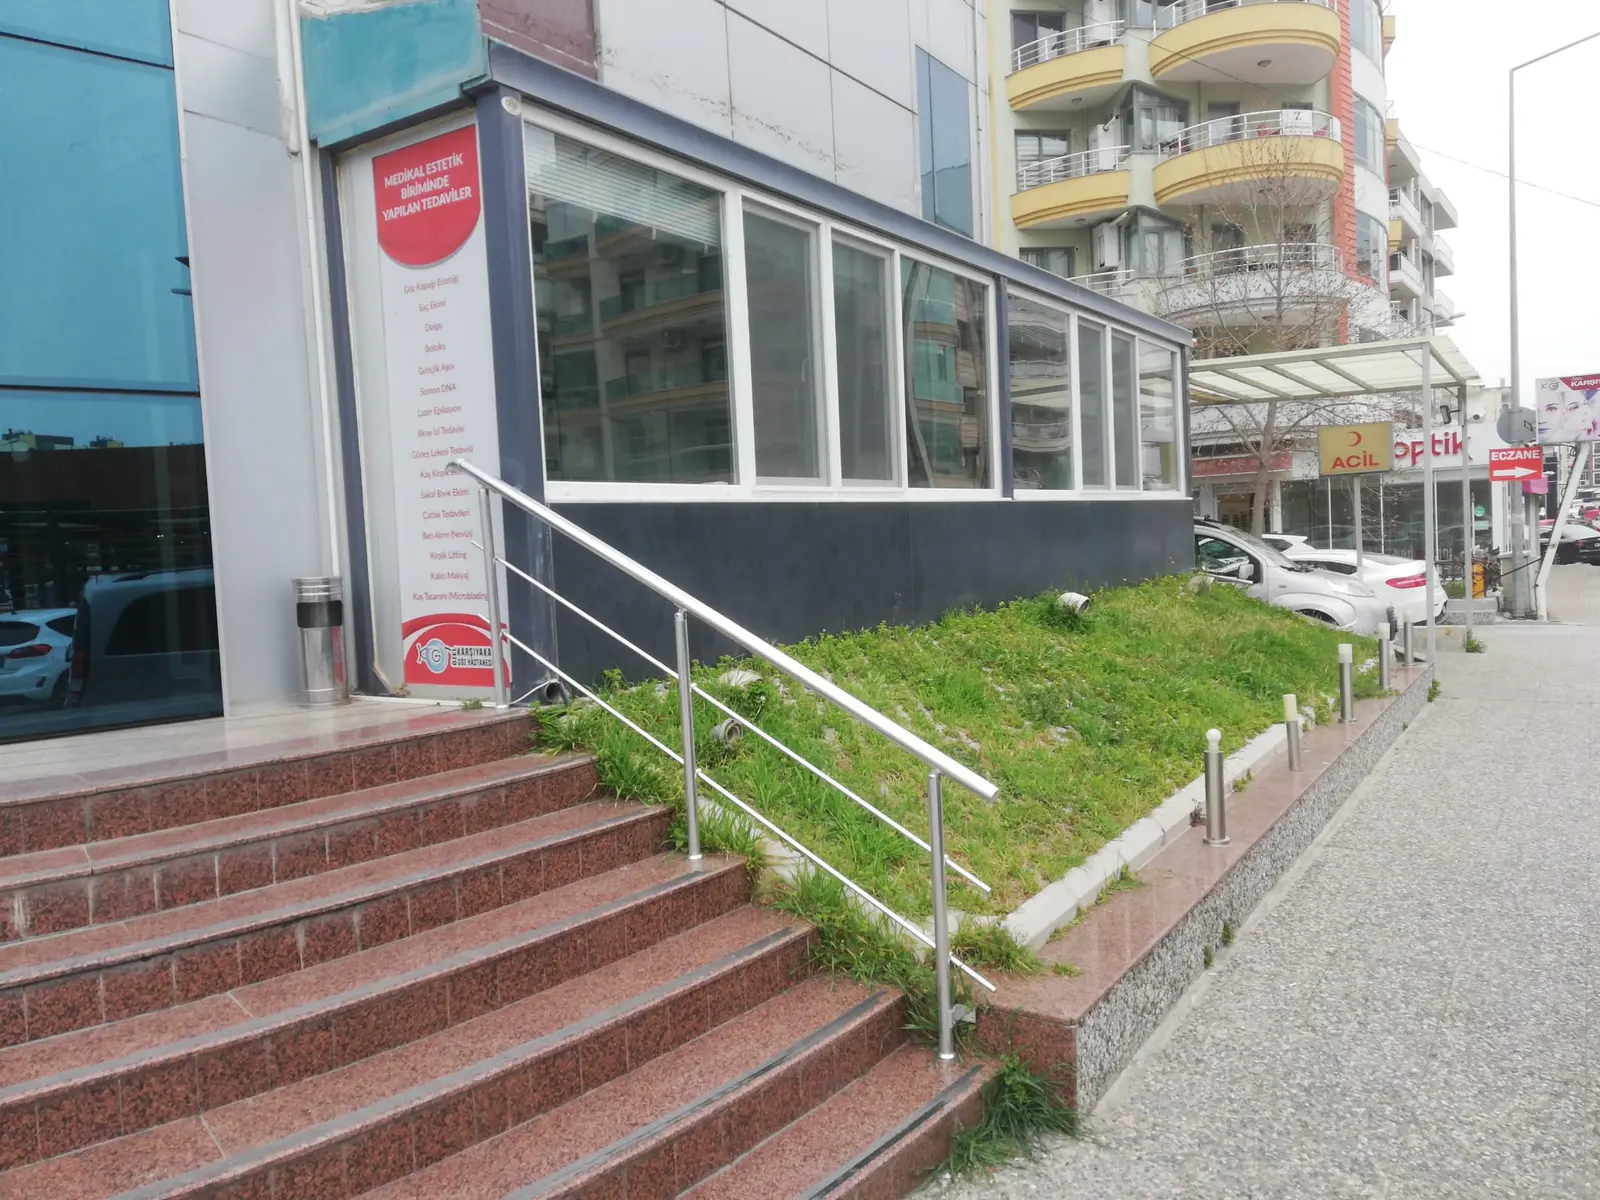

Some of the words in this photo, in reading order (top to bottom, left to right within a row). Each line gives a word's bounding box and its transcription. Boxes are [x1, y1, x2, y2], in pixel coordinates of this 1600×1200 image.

[383, 167, 425, 188] MEDİKAL
[425, 152, 464, 175] ESTETİK
[400, 174, 450, 200] BİRİMİNDE
[382, 201, 421, 221] YAPILAN
[421, 186, 472, 211] TEDAVİLER
[441, 382, 457, 393] DNA
[1331, 450, 1380, 469] ACİL
[1491, 449, 1540, 460] ECZANE
[456, 647, 492, 658] KARŞIYAKA
[467, 659, 493, 668] HASTANES
